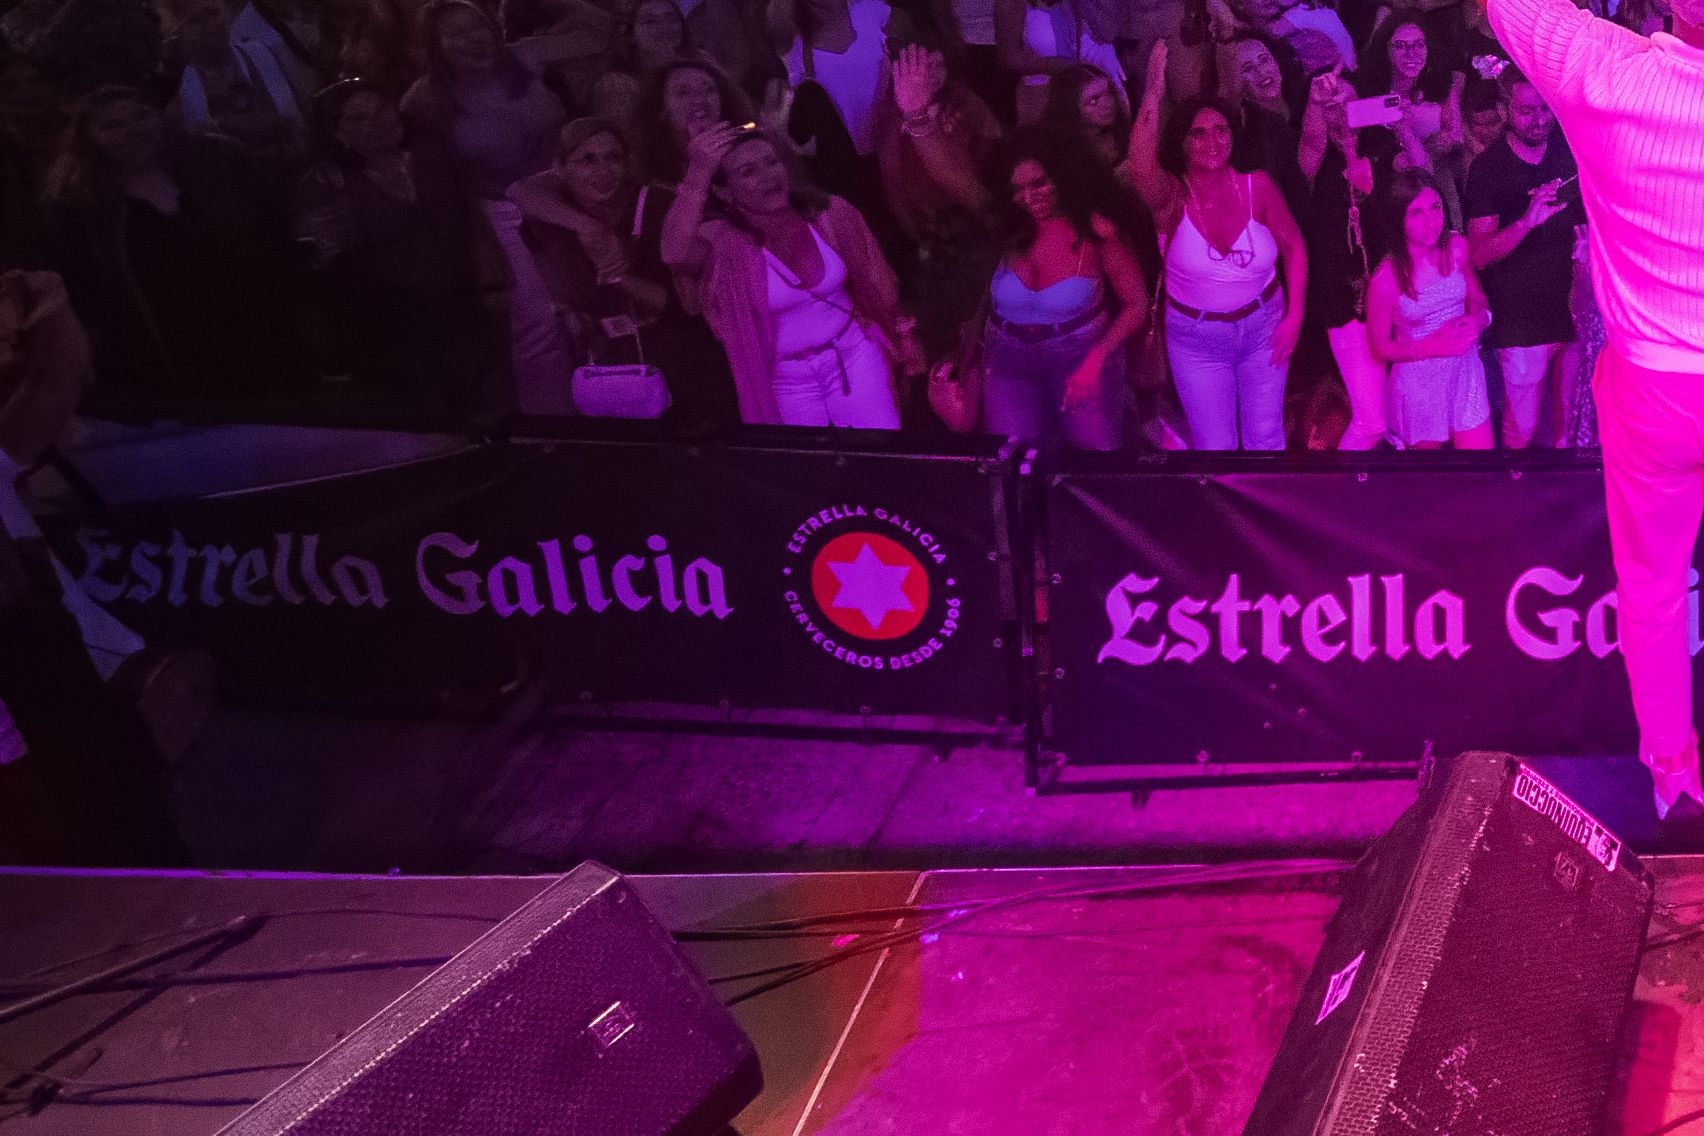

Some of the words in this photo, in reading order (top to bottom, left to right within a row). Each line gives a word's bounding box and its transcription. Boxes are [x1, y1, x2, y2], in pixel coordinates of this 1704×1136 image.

[76, 527, 390, 609] Estrella
[415, 532, 735, 620] Galicia
[786, 504, 868, 553] ESTRELLA
[873, 508, 947, 564] GALICIA
[784, 590, 885, 671] CERVECEROS
[889, 637, 943, 671] DESDE
[938, 597, 962, 638] 1906
[1097, 572, 1472, 666] Estrella
